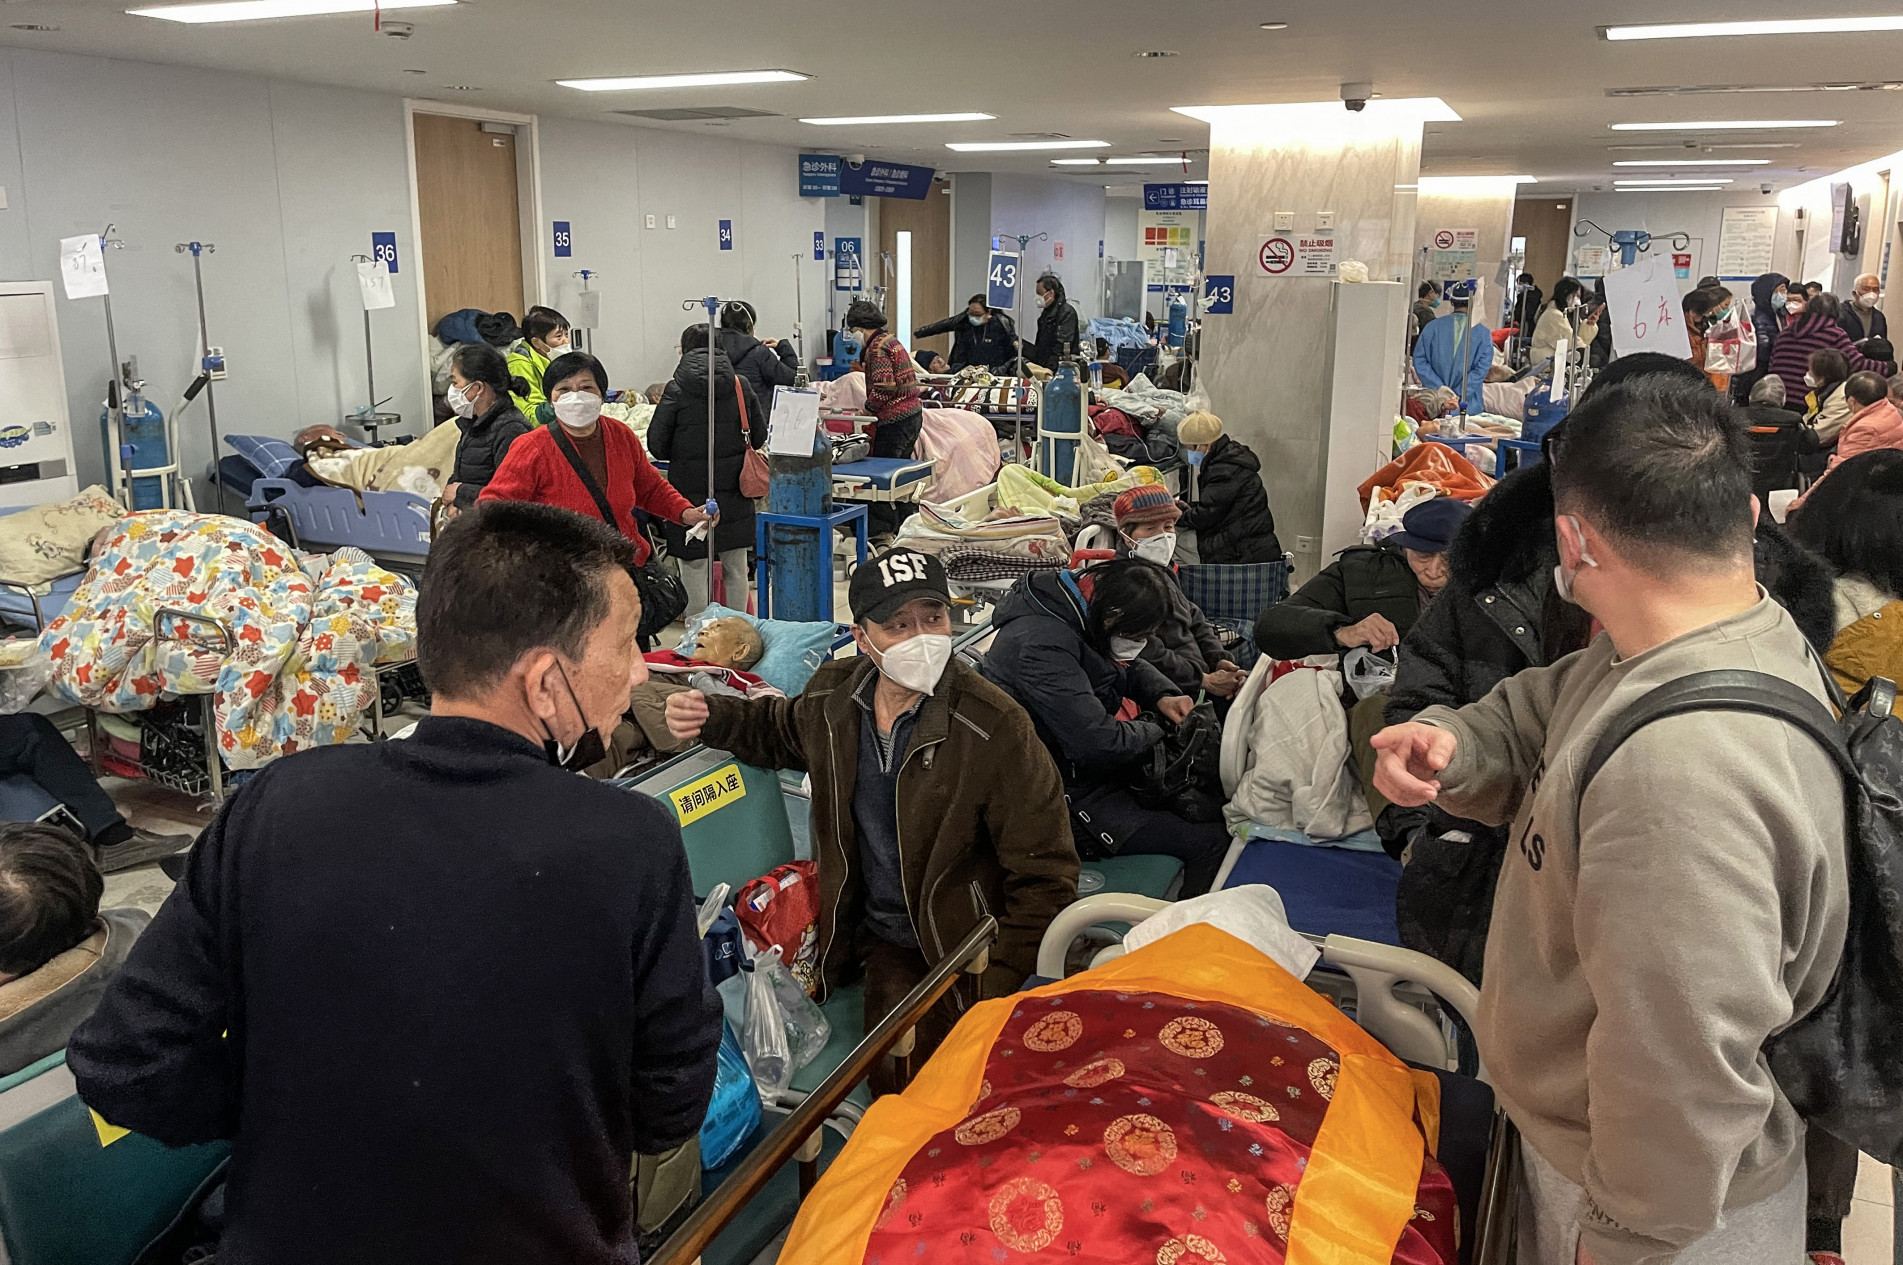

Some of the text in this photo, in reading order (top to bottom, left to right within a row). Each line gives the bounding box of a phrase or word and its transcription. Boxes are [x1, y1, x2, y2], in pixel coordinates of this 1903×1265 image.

[802, 160, 837, 172] 急诊外科
[555, 231, 570, 247] 35
[720, 228, 731, 242] 34
[375, 244, 395, 262] 36
[815, 239, 824, 251] 33
[841, 241, 855, 253] 06
[990, 263, 1016, 288] 43
[1210, 286, 1231, 303] 43
[877, 552, 928, 588] ISF
[678, 773, 740, 815] 请间隔入座
